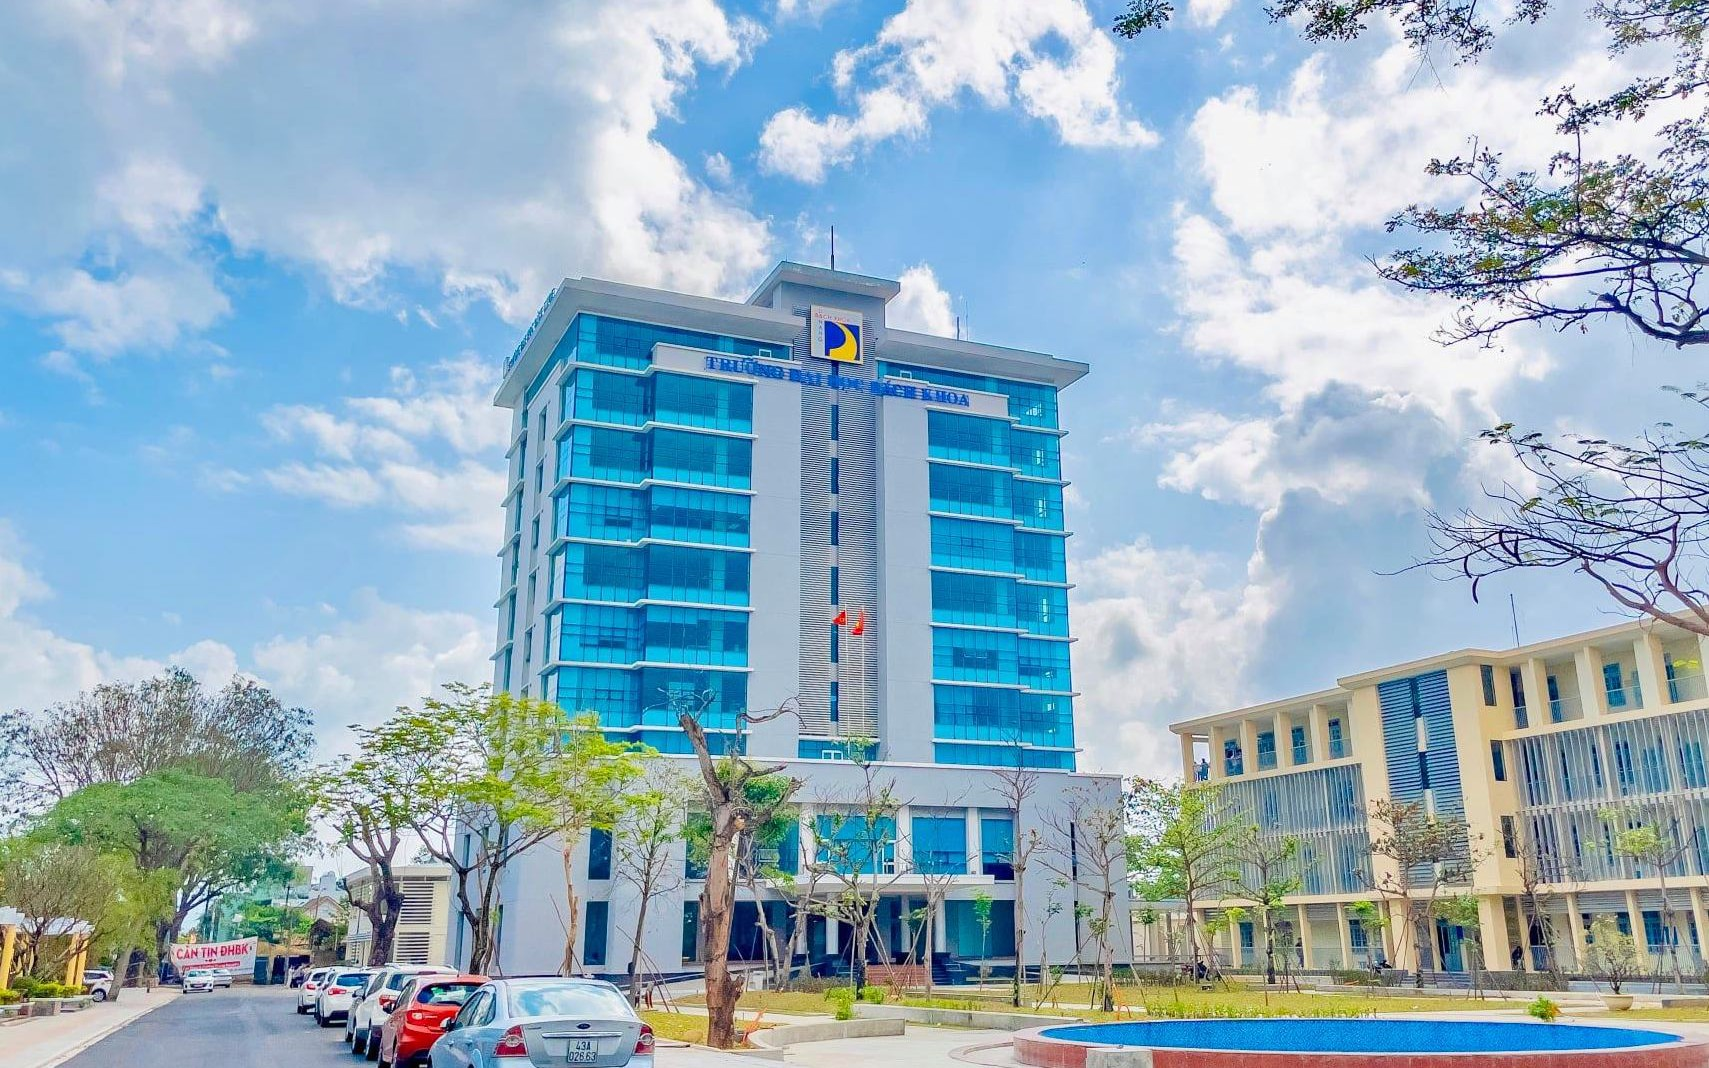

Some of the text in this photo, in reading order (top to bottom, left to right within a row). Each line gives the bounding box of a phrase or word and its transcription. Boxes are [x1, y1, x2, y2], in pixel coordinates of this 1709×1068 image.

[922, 388, 970, 407] KHOA
[201, 946, 218, 958] TIN
[220, 943, 249, 957] ĐHBK
[576, 1040, 591, 1051] 43A
